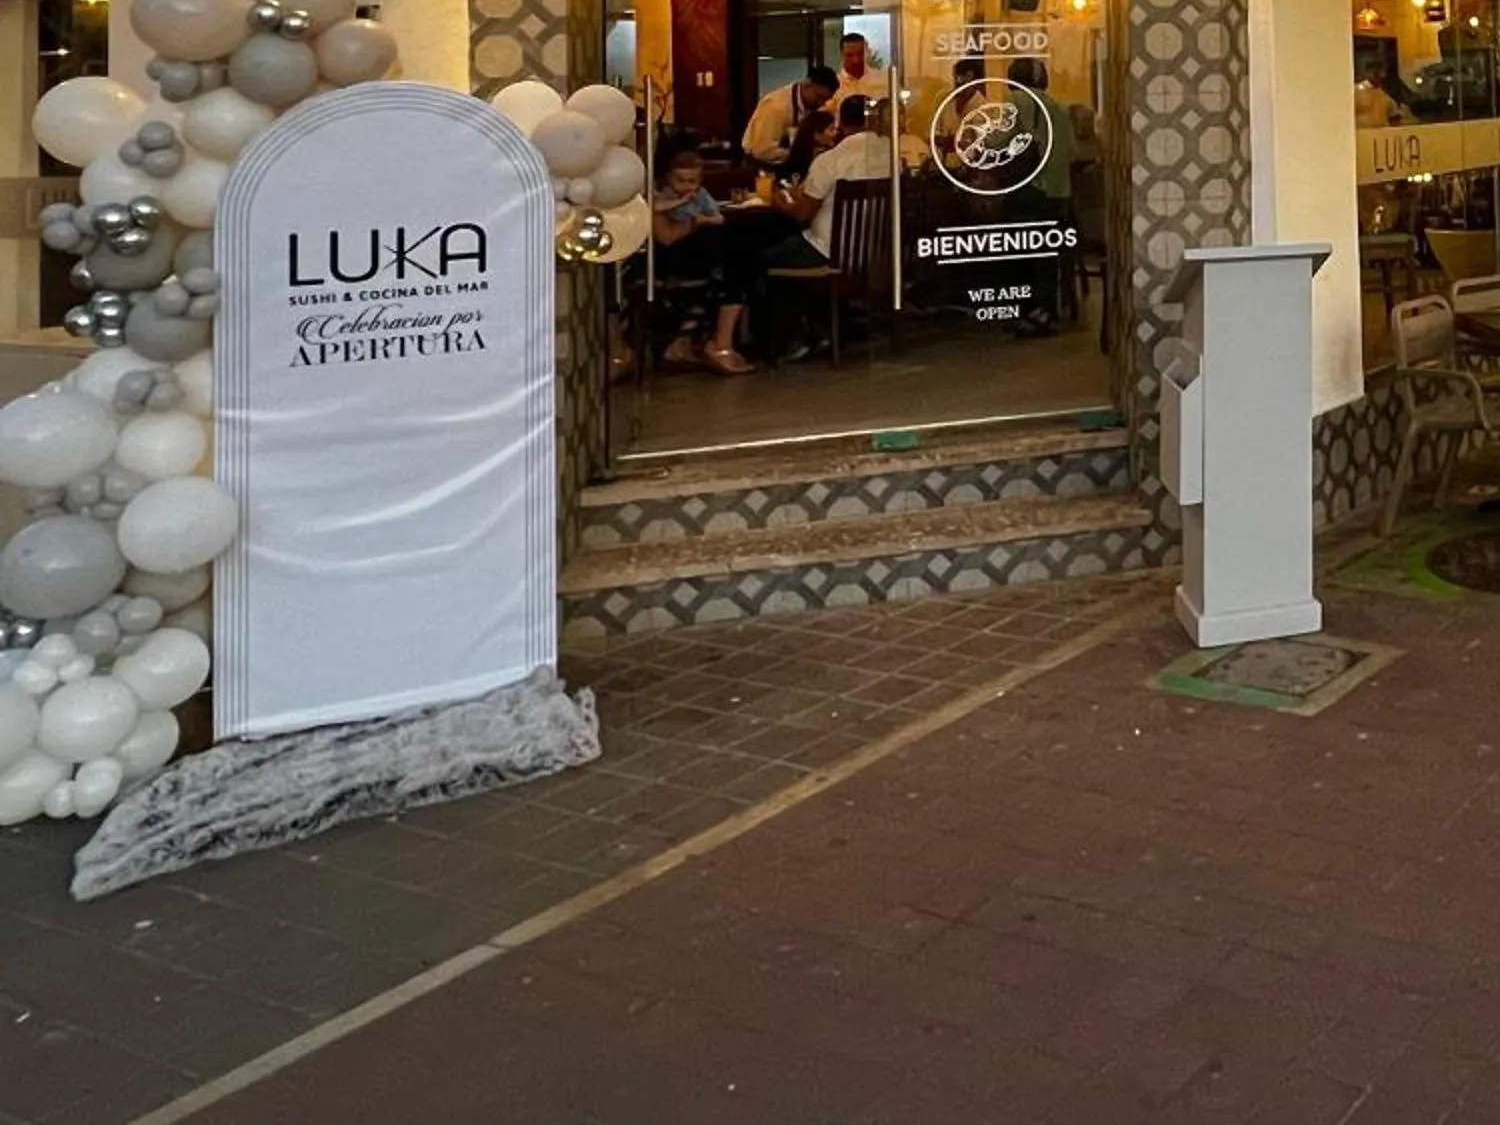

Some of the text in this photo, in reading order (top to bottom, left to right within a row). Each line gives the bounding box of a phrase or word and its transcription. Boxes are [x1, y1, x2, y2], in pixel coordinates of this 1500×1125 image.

[935, 31, 1049, 53] SEAFOOD
[288, 222, 487, 287] LUKA
[916, 227, 1078, 258] BIENVENIDOS
[288, 293, 338, 307] SUSHI
[342, 291, 353, 303] &
[358, 287, 419, 302] COCINA
[456, 280, 489, 293] MAR
[967, 284, 1032, 303] WE ARE
[975, 304, 1020, 322] OPEN
[289, 328, 487, 368] APERTURA
